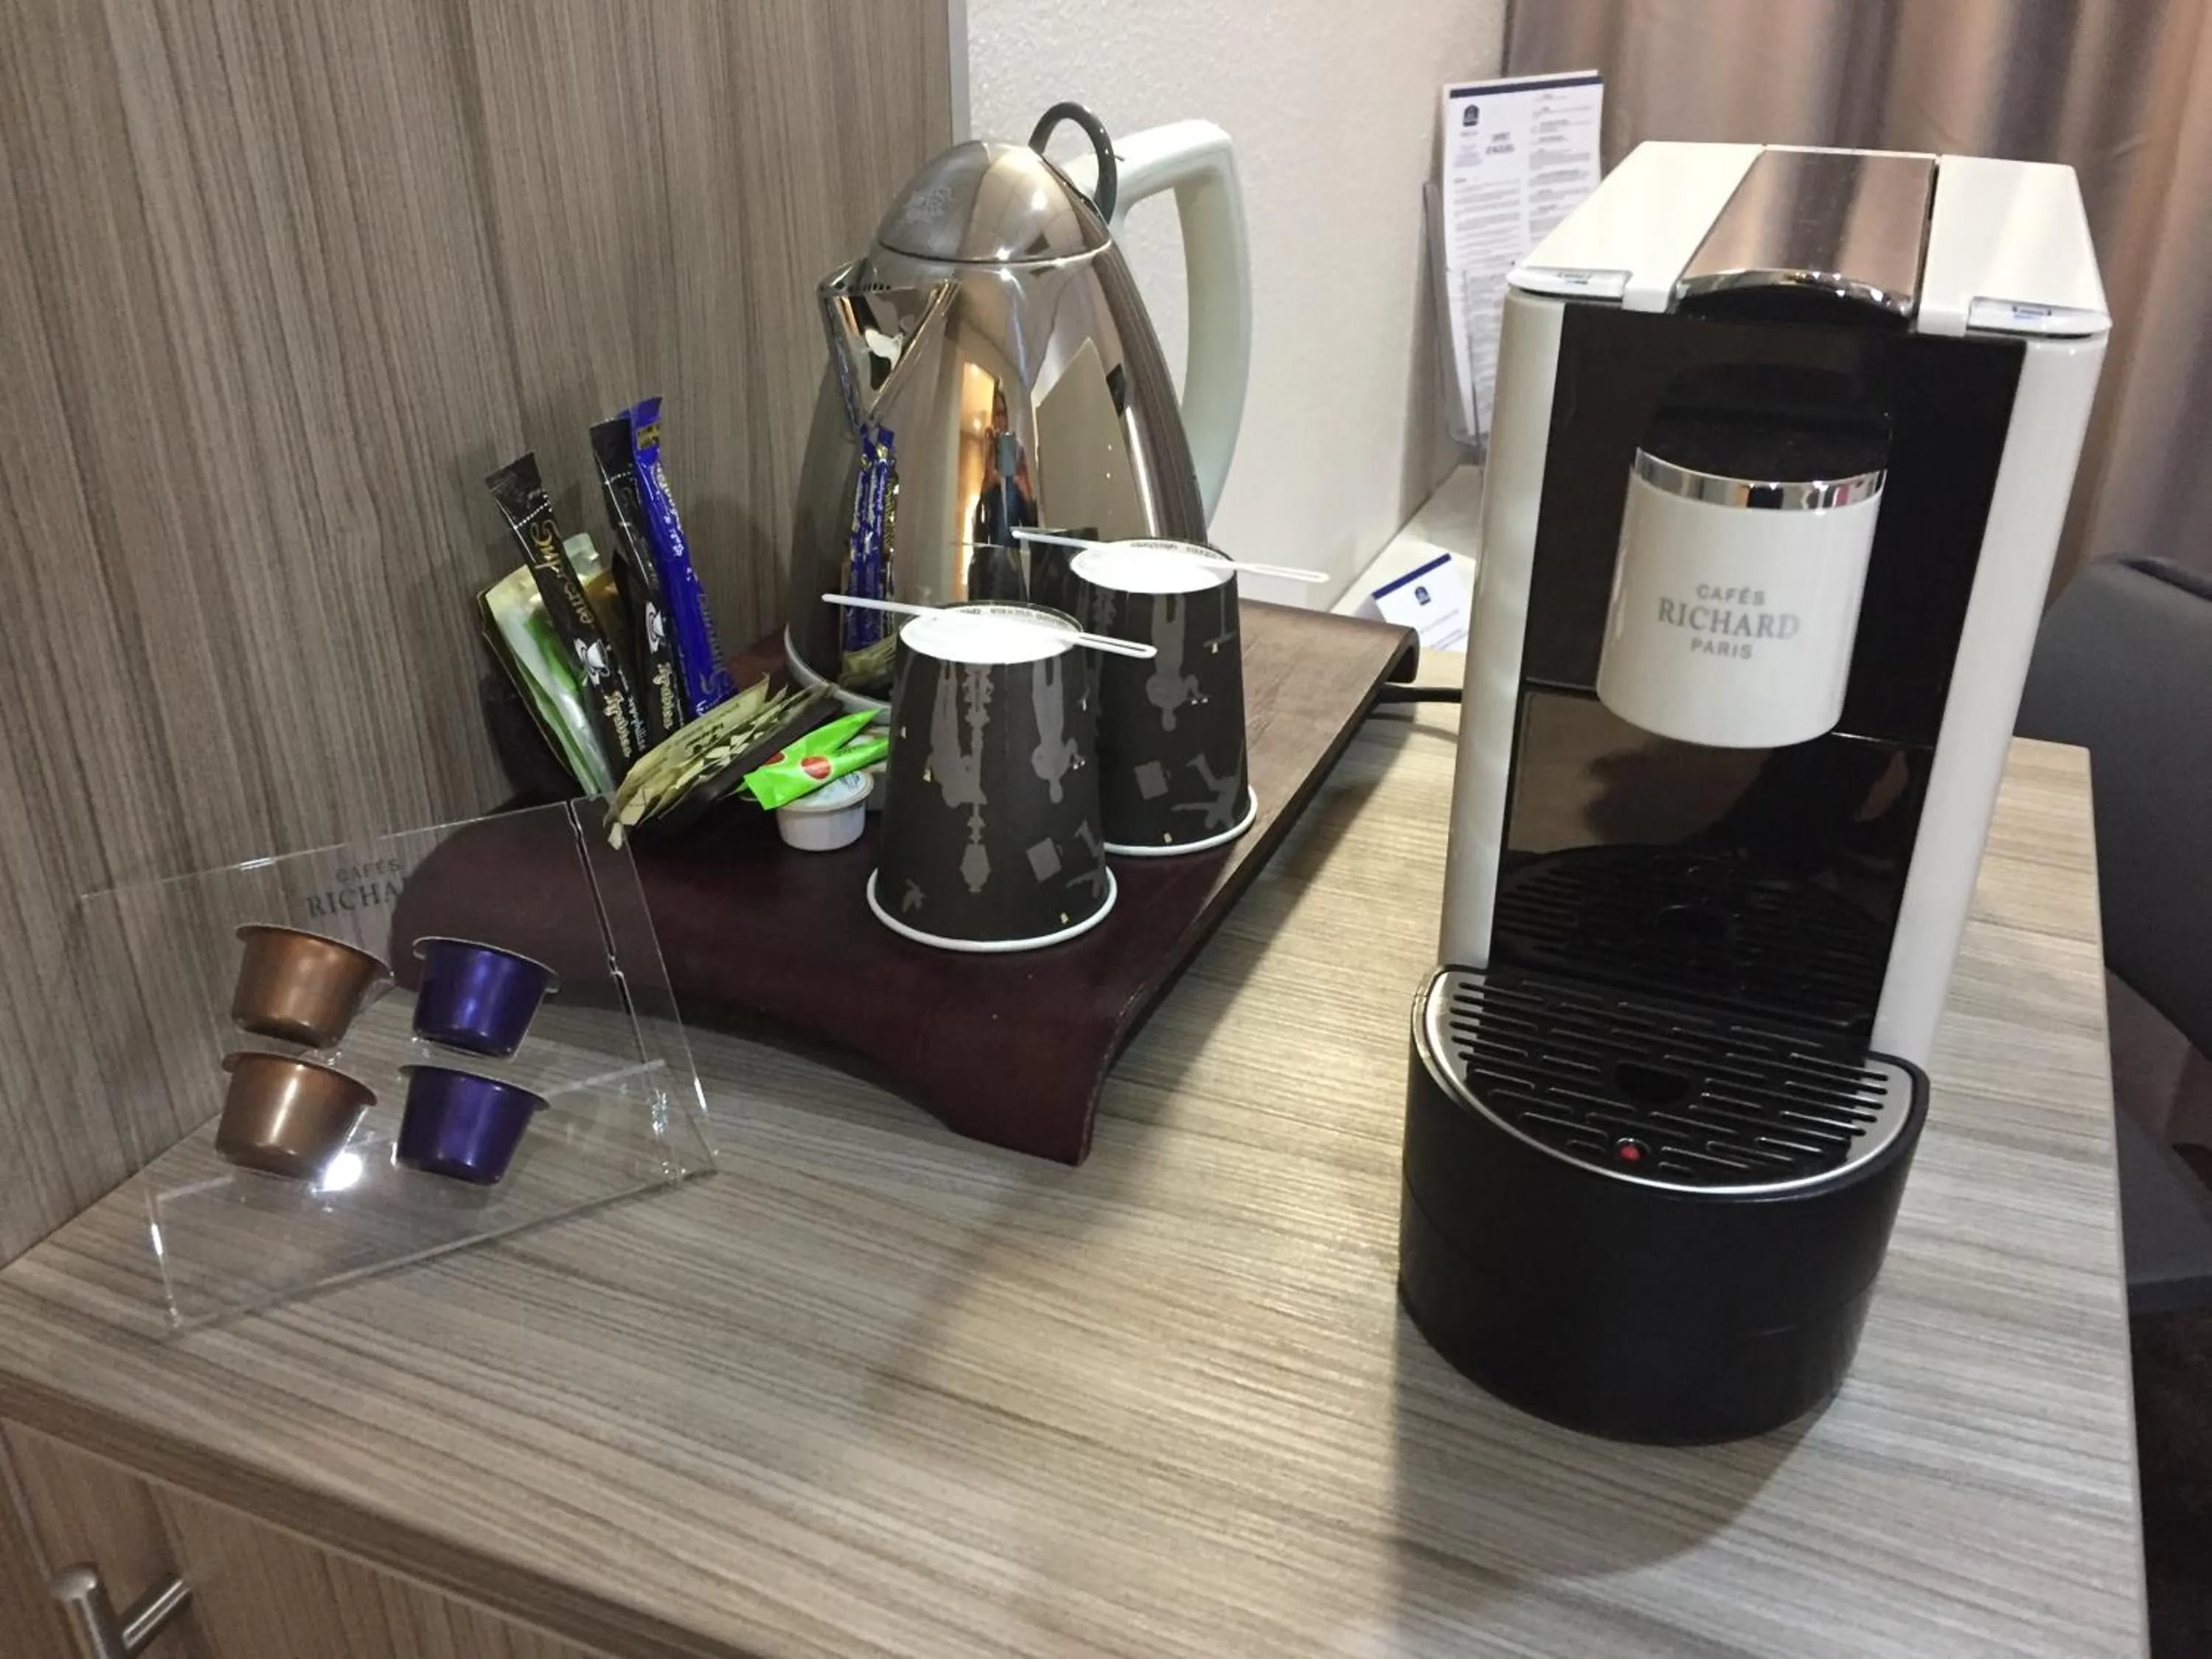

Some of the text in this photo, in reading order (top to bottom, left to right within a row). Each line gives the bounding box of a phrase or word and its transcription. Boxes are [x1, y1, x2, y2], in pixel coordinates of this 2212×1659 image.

[1696, 582, 1766, 607] CAFÉS
[1658, 596, 1801, 640] RICHARD
[1690, 636, 1753, 661] PARIS
[335, 858, 401, 884] CAFÉS
[306, 880, 403, 919] RICHA
